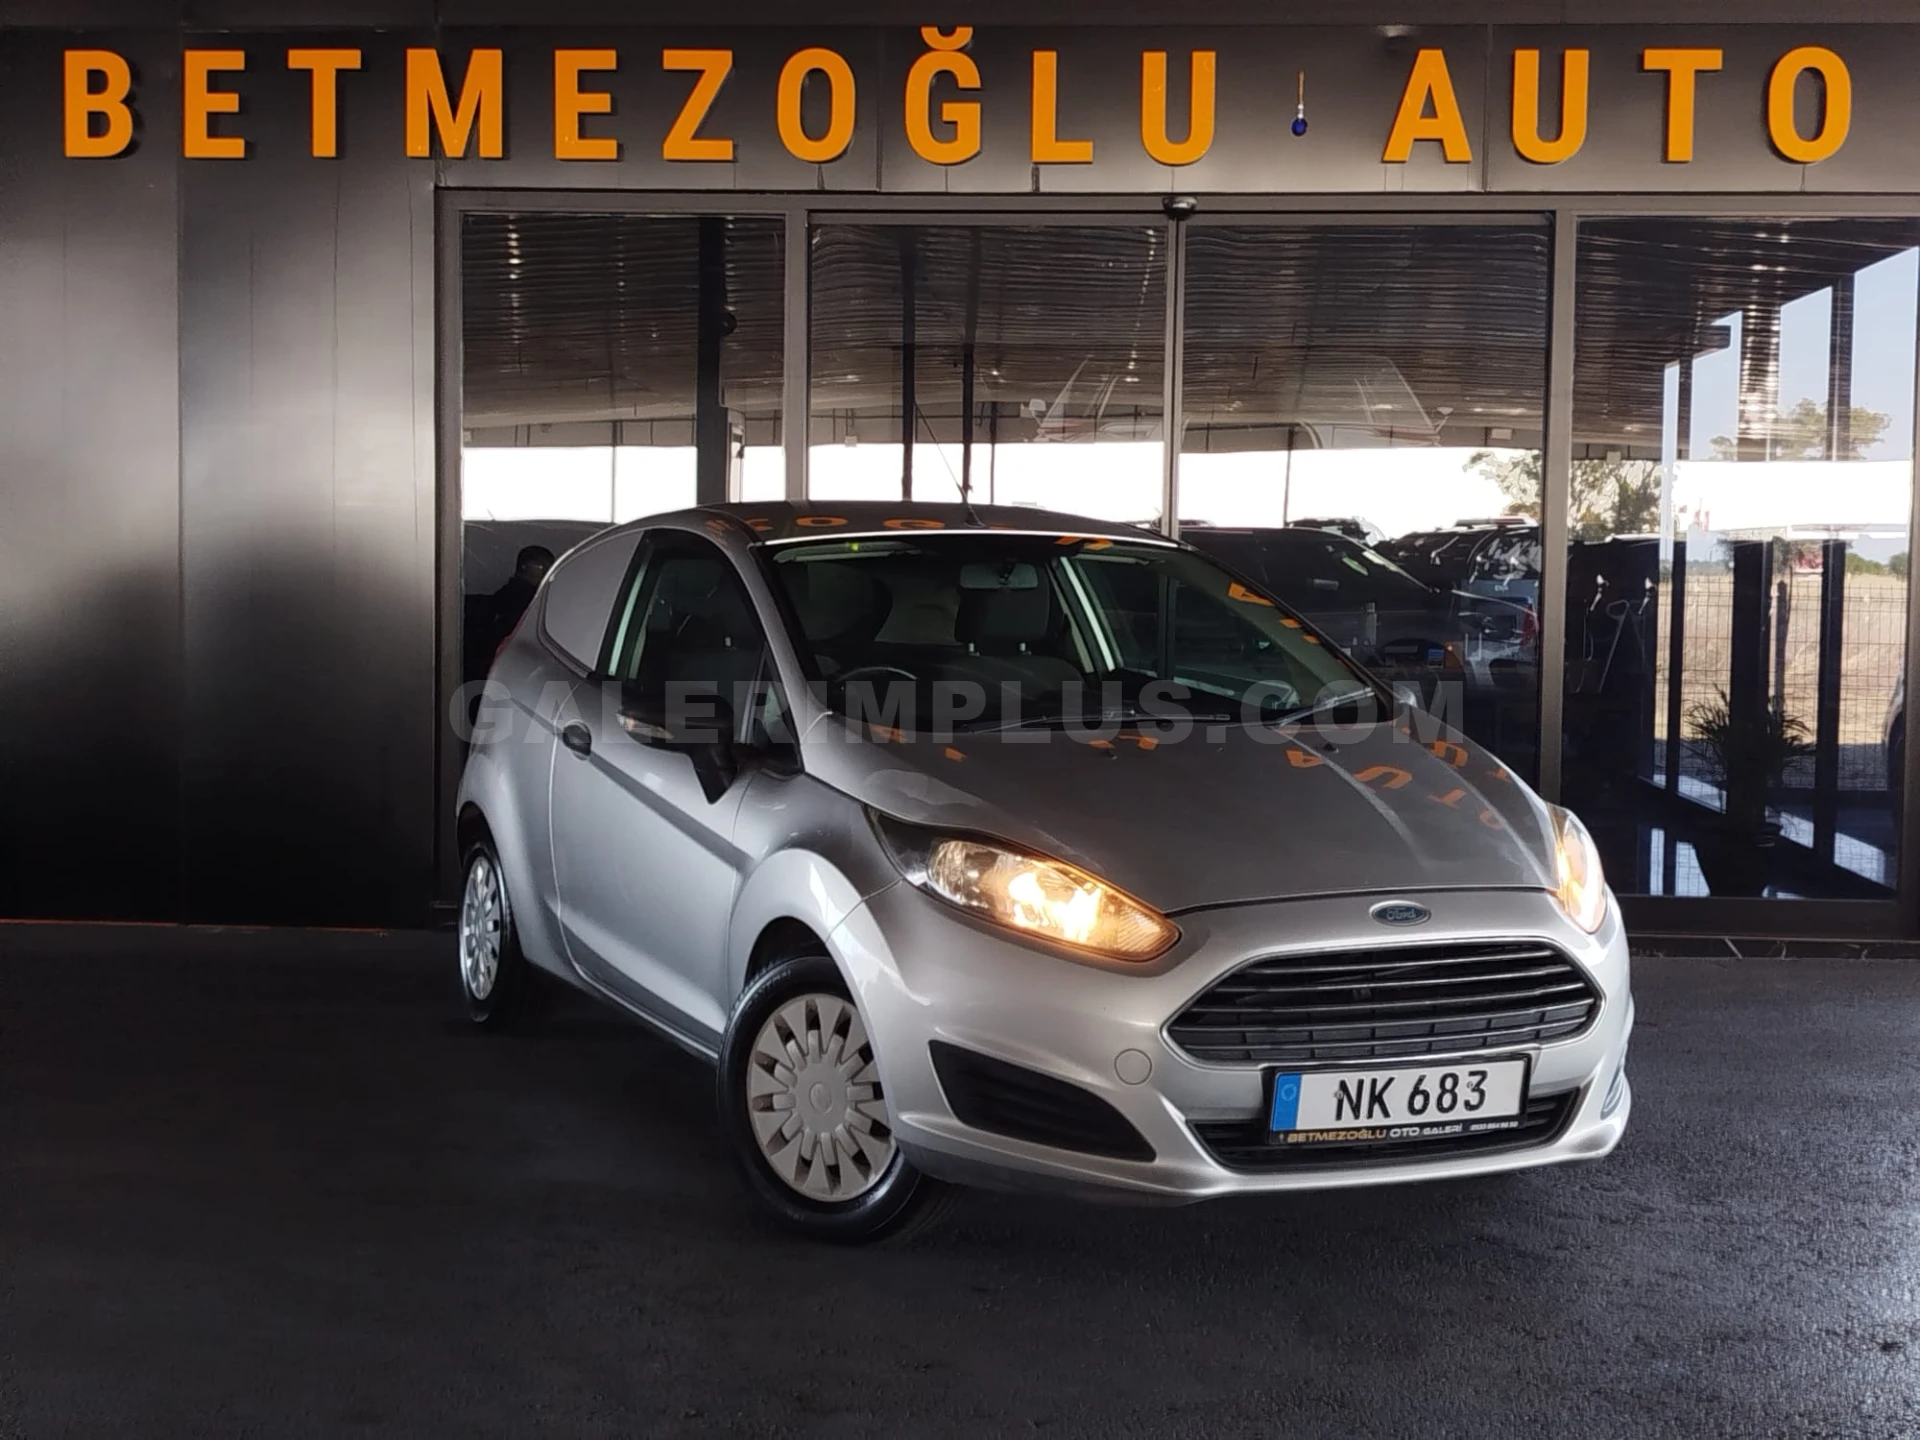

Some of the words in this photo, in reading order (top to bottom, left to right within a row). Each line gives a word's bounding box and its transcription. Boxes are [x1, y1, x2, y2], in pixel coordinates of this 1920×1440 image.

[64, 27, 1215, 164] BETMEZOĞLU
[1383, 48, 1851, 163] AUTO
[1387, 908, 1416, 920] Ford
[1334, 1076, 1396, 1122] NK
[1406, 1069, 1489, 1116] 683
[1389, 1127, 1420, 1138] OTO
